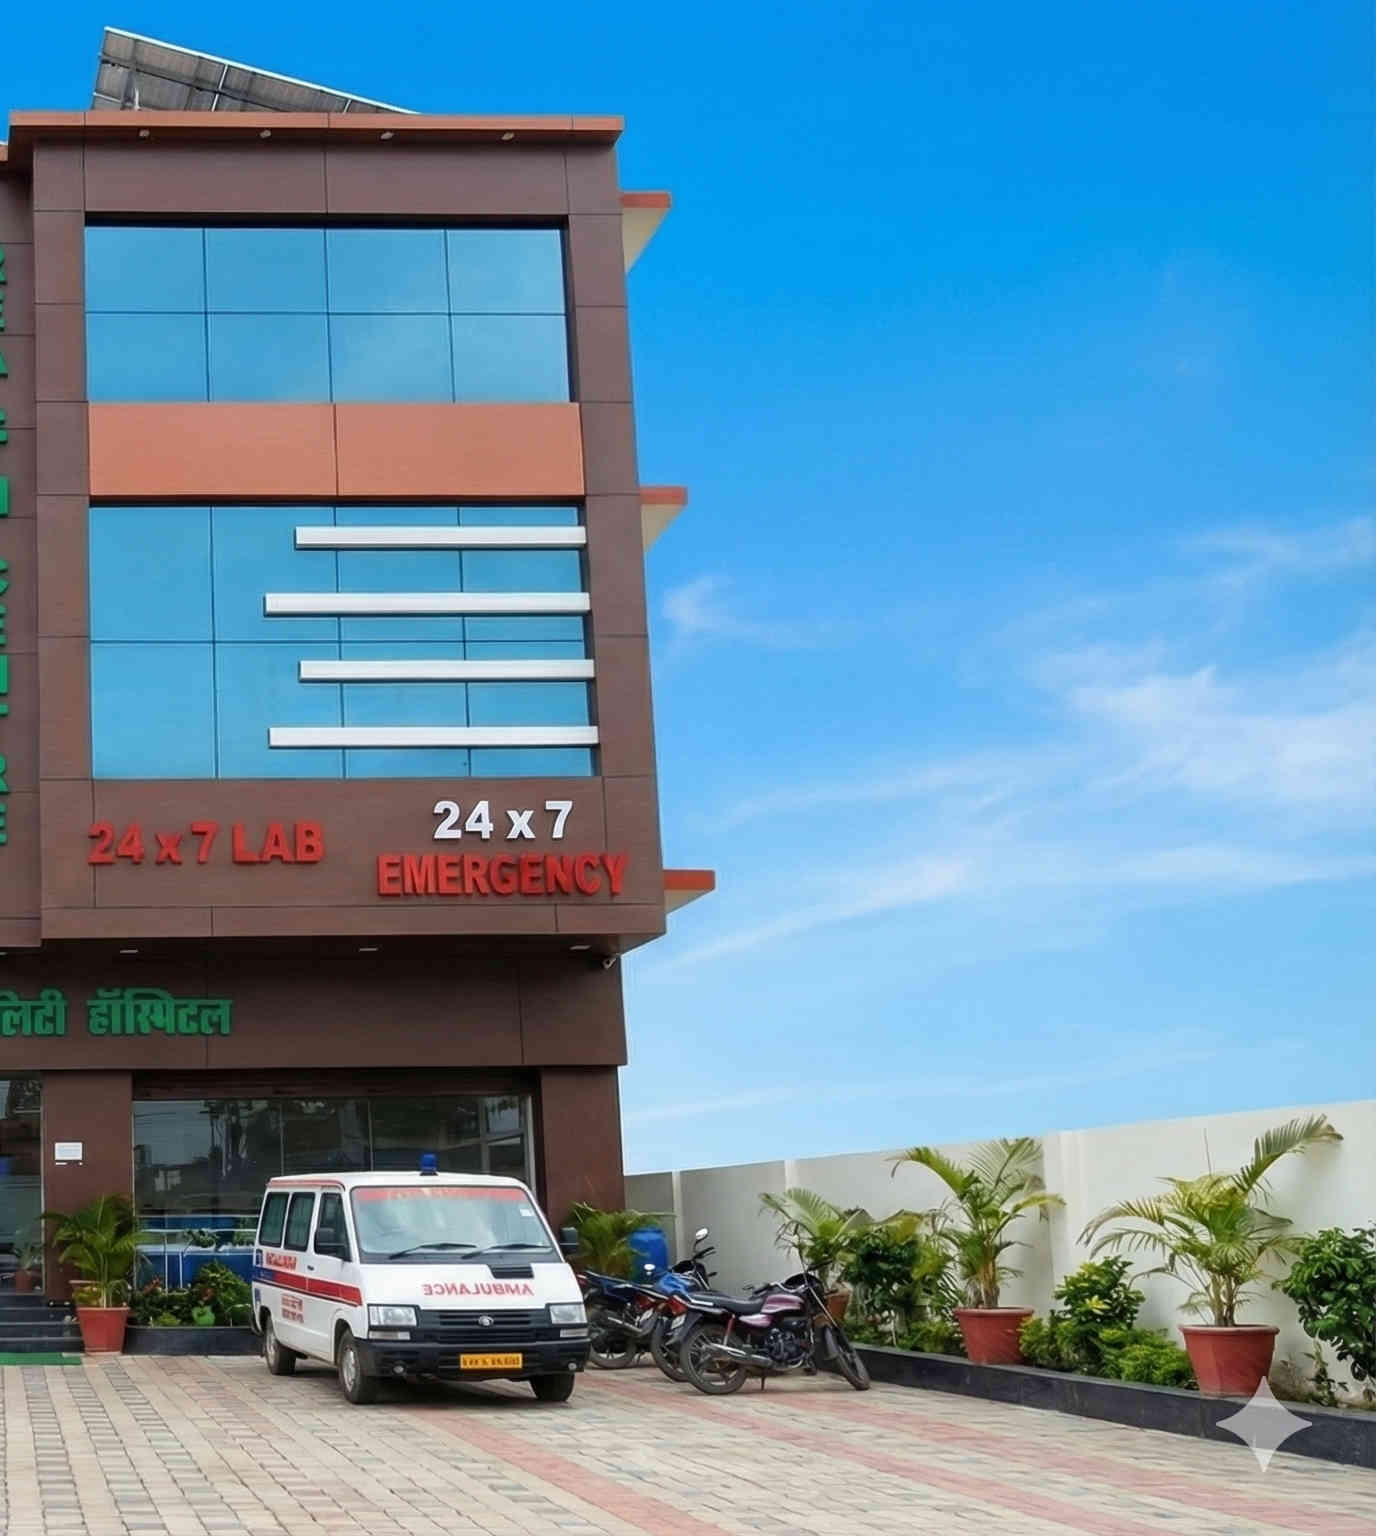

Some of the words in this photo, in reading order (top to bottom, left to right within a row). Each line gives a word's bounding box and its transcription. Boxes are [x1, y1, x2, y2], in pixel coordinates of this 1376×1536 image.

[88, 820, 145, 866] 24
[155, 832, 182, 865] x
[191, 820, 220, 865] 7
[232, 819, 326, 865] LAB
[433, 800, 494, 840] 24
[506, 810, 536, 839] x
[545, 800, 573, 839] 7
[376, 851, 629, 897] EMERGENCY
